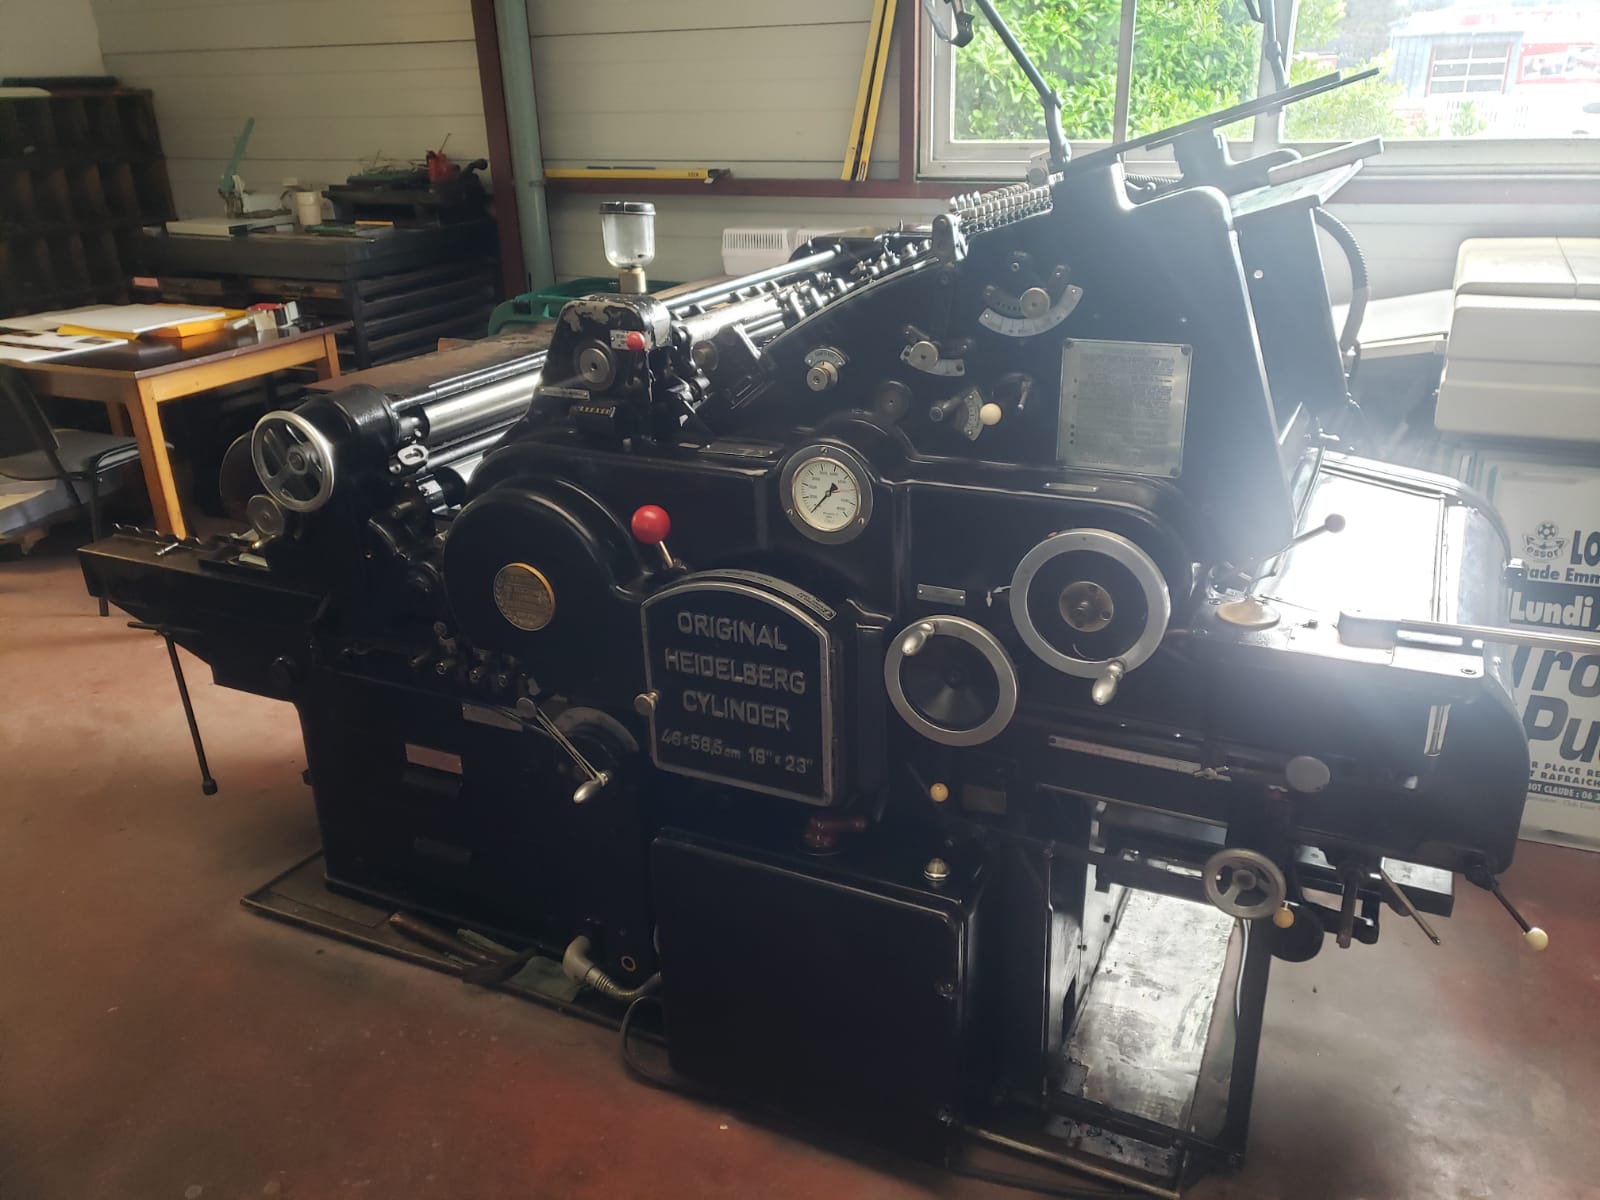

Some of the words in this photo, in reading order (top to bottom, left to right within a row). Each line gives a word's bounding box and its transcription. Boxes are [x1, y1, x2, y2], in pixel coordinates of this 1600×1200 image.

[1527, 565, 1560, 580] ade
[1510, 592, 1593, 627] Lundi
[677, 611, 788, 650] ORIGINAL
[665, 648, 806, 695] HEIDELBERG
[682, 689, 791, 731] CYLINDER
[1544, 762, 1581, 775] PLACE
[1544, 785, 1575, 797] CLAUDE
